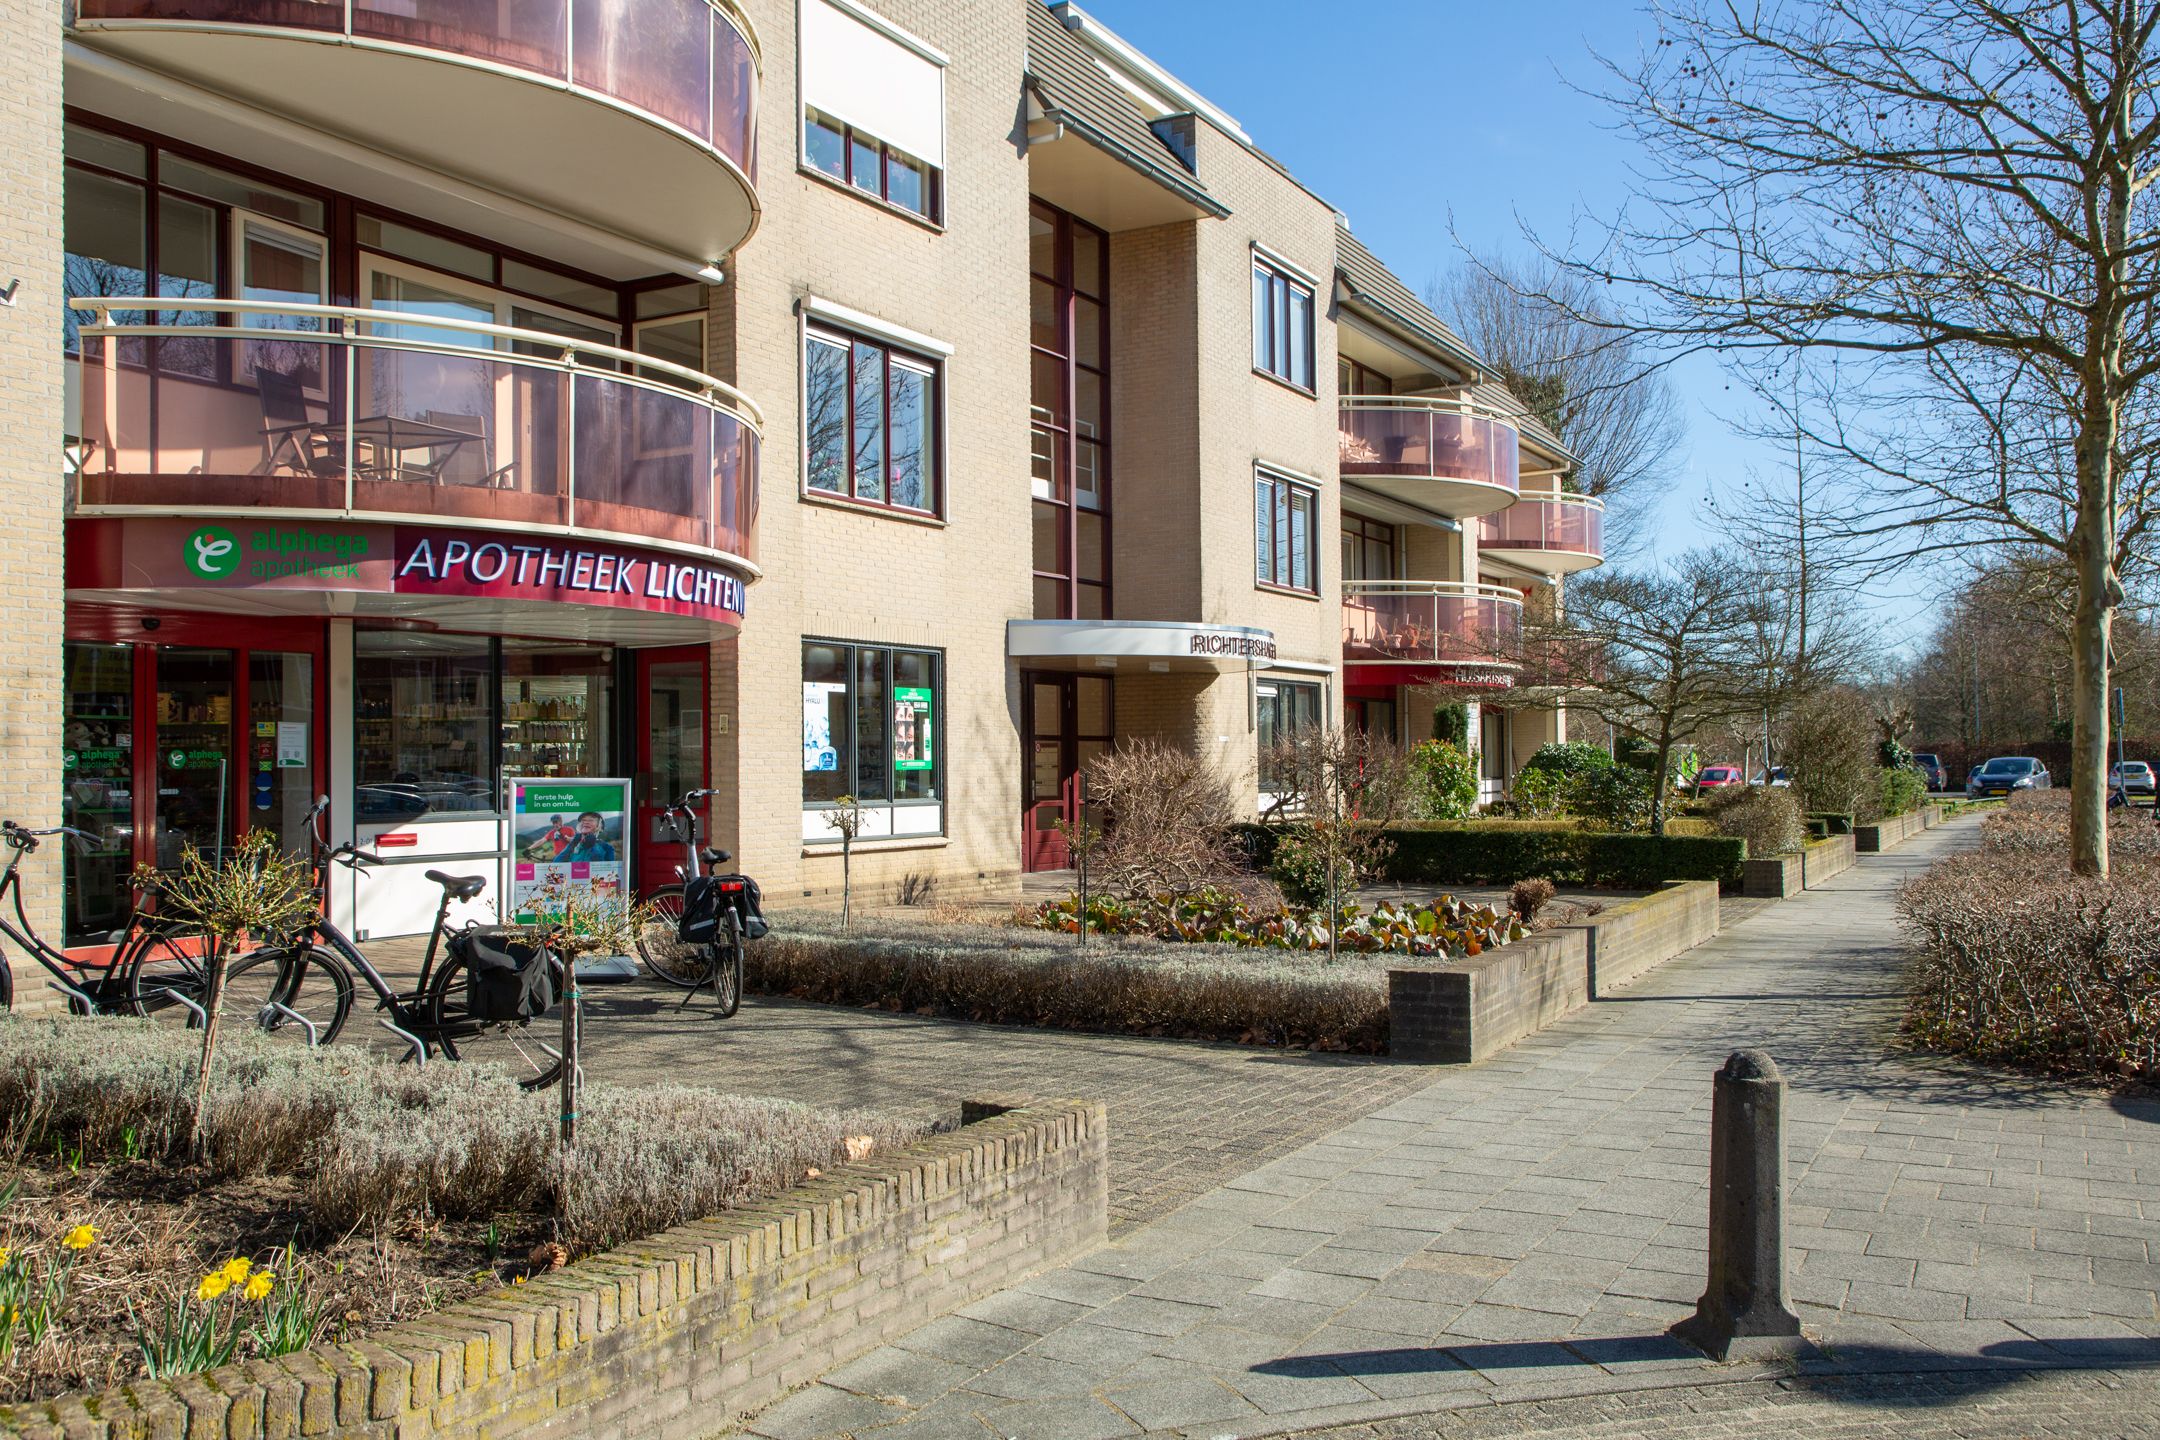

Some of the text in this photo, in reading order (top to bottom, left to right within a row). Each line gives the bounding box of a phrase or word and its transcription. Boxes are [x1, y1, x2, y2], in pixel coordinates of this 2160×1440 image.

[251, 527, 369, 559] alphega
[251, 555, 362, 583] apotheek
[399, 538, 637, 593] APOTHEEK
[81, 750, 121, 762] alphega
[188, 751, 223, 762] alphega
[557, 793, 574, 802] hulp
